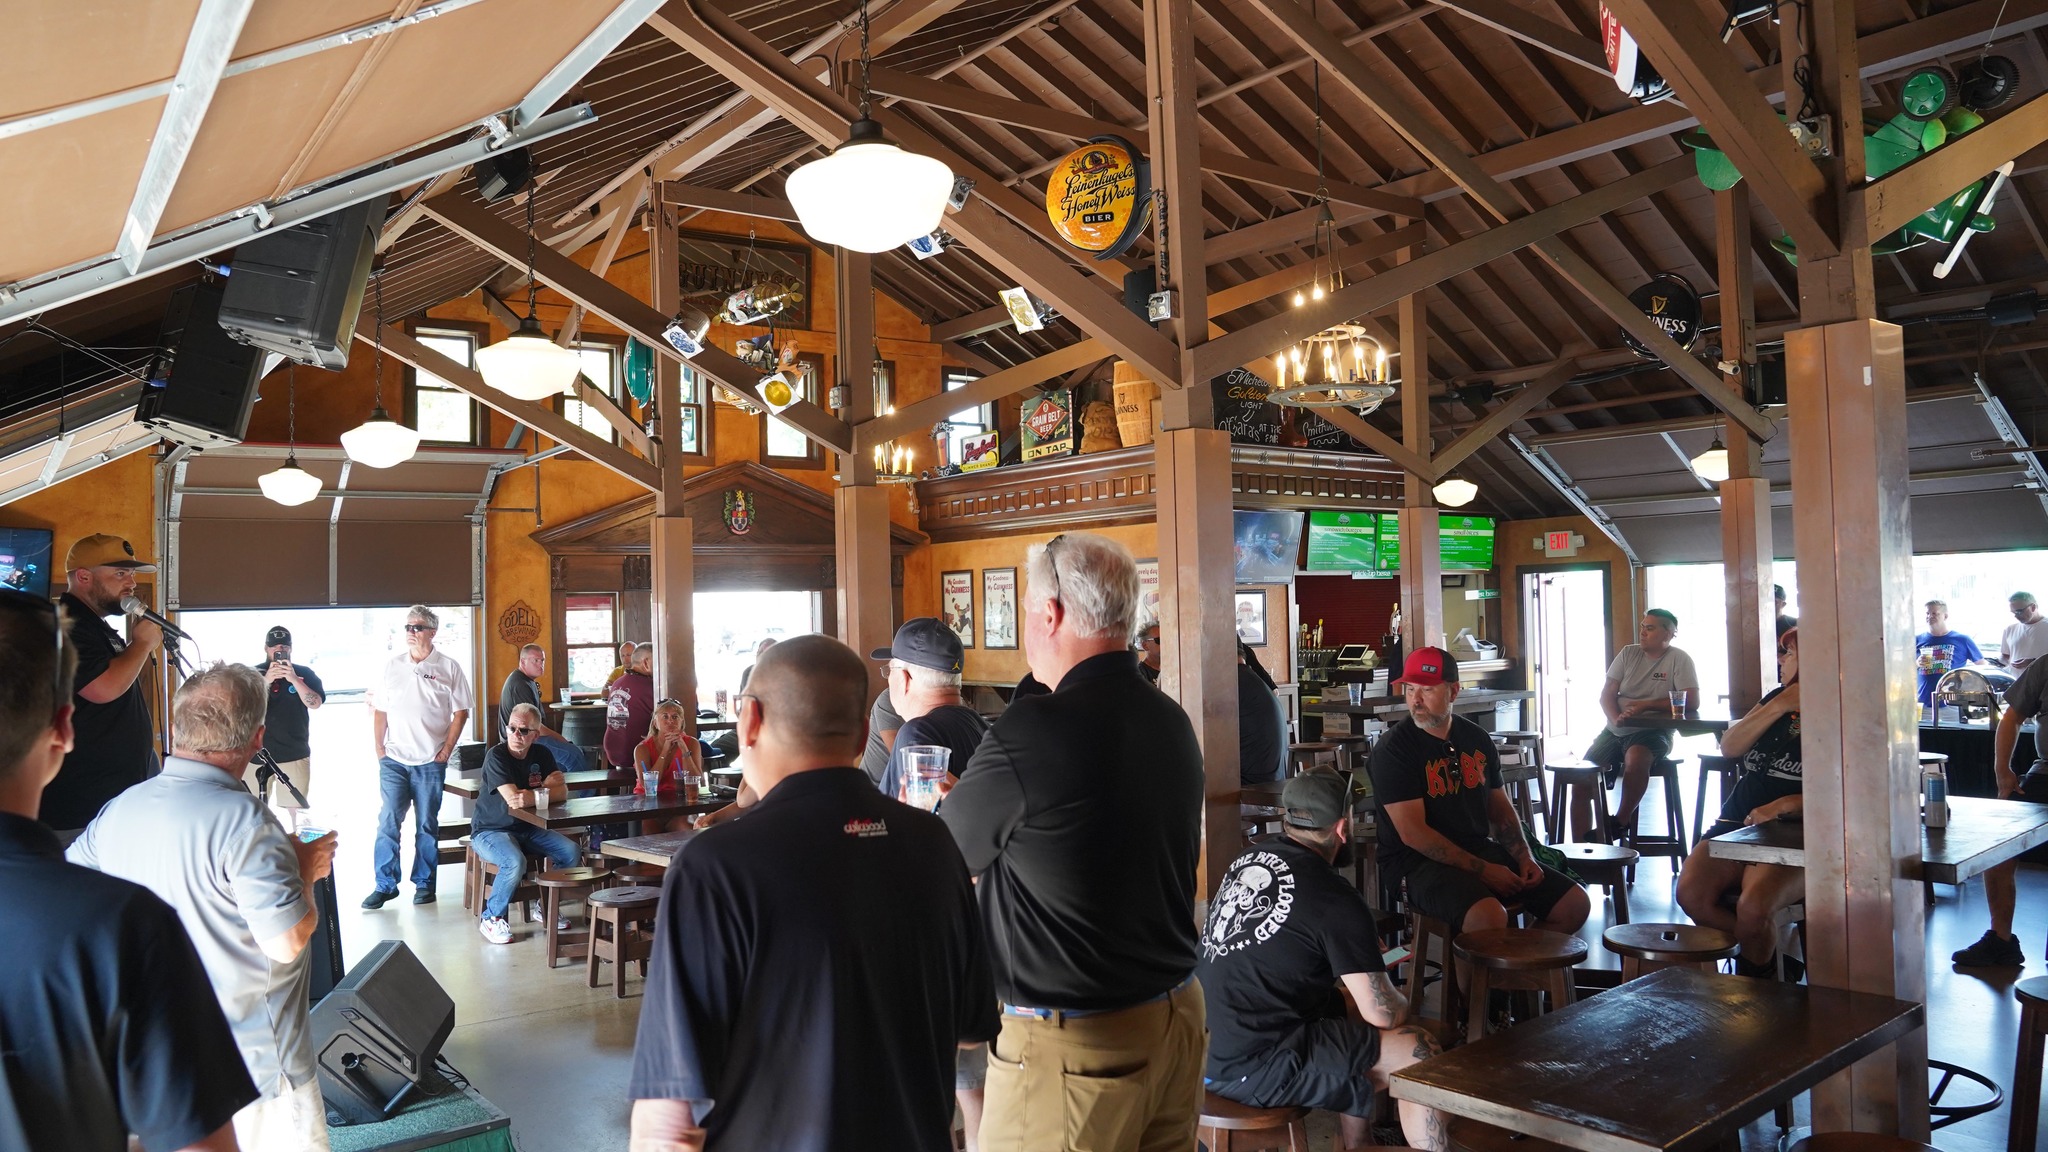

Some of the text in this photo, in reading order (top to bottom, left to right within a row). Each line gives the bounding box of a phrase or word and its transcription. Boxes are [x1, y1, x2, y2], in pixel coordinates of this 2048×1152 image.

[1061, 184, 1135, 222] Honey Weiss
[1084, 213, 1112, 222] BIER
[1032, 410, 1060, 427] GRAIN BELT
[1040, 424, 1052, 433] BEER
[1028, 443, 1066, 458] ON TAP
[1550, 532, 1568, 550] EXIT
[504, 608, 537, 628] ODELL
[506, 626, 537, 636] BREWING
[1229, 852, 1254, 872] THE
[1253, 851, 1291, 875] BITCH
